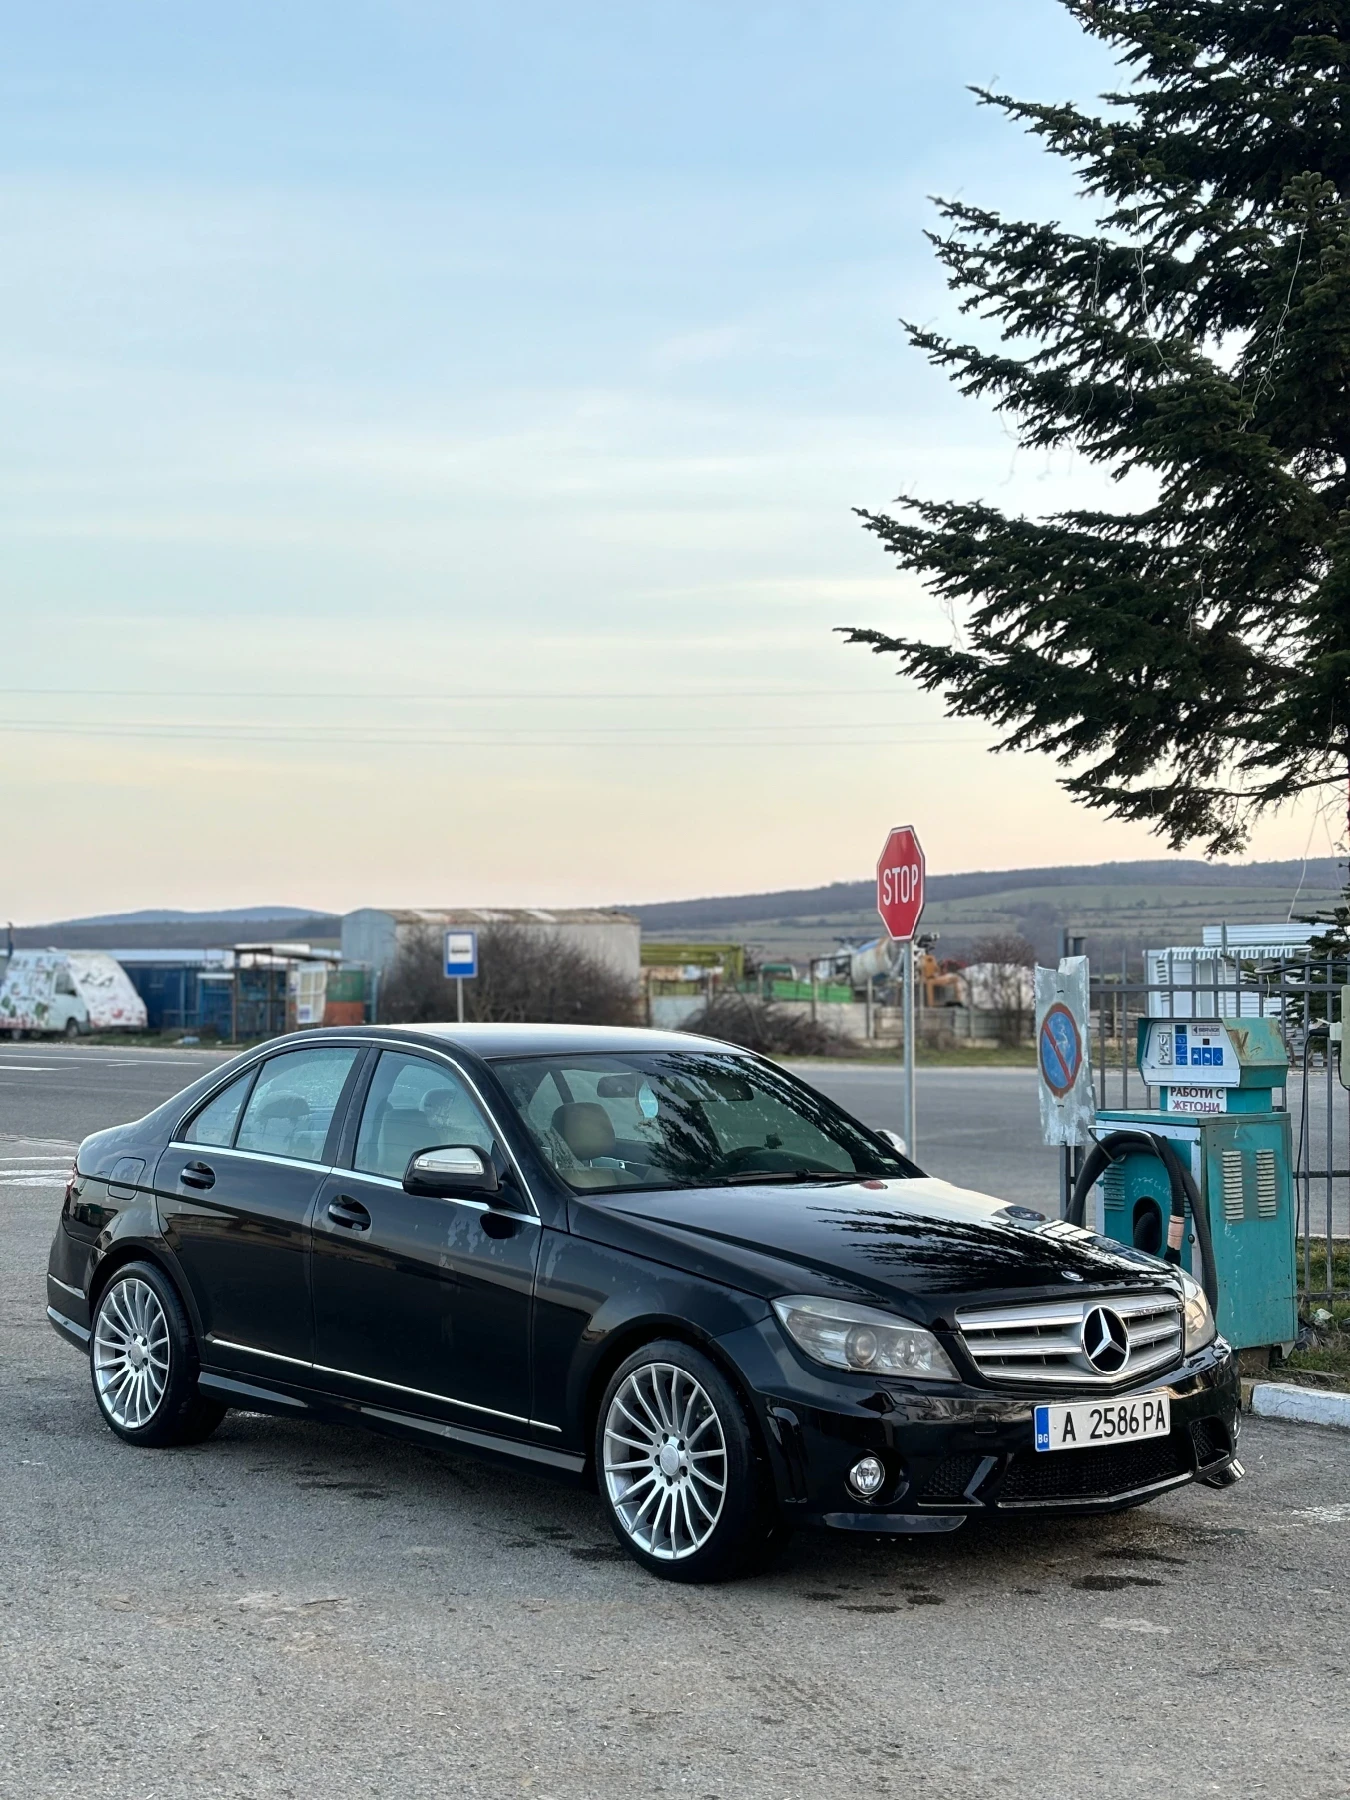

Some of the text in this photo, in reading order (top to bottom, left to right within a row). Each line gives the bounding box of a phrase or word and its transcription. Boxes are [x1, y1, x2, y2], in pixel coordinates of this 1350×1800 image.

[883, 863, 919, 906] STOP
[1170, 1087, 1213, 1098] РАБОТИ
[1172, 1100, 1220, 1112] ЖЕТОНИ
[1062, 1411, 1076, 1442] A
[1037, 1433, 1049, 1444] BG
